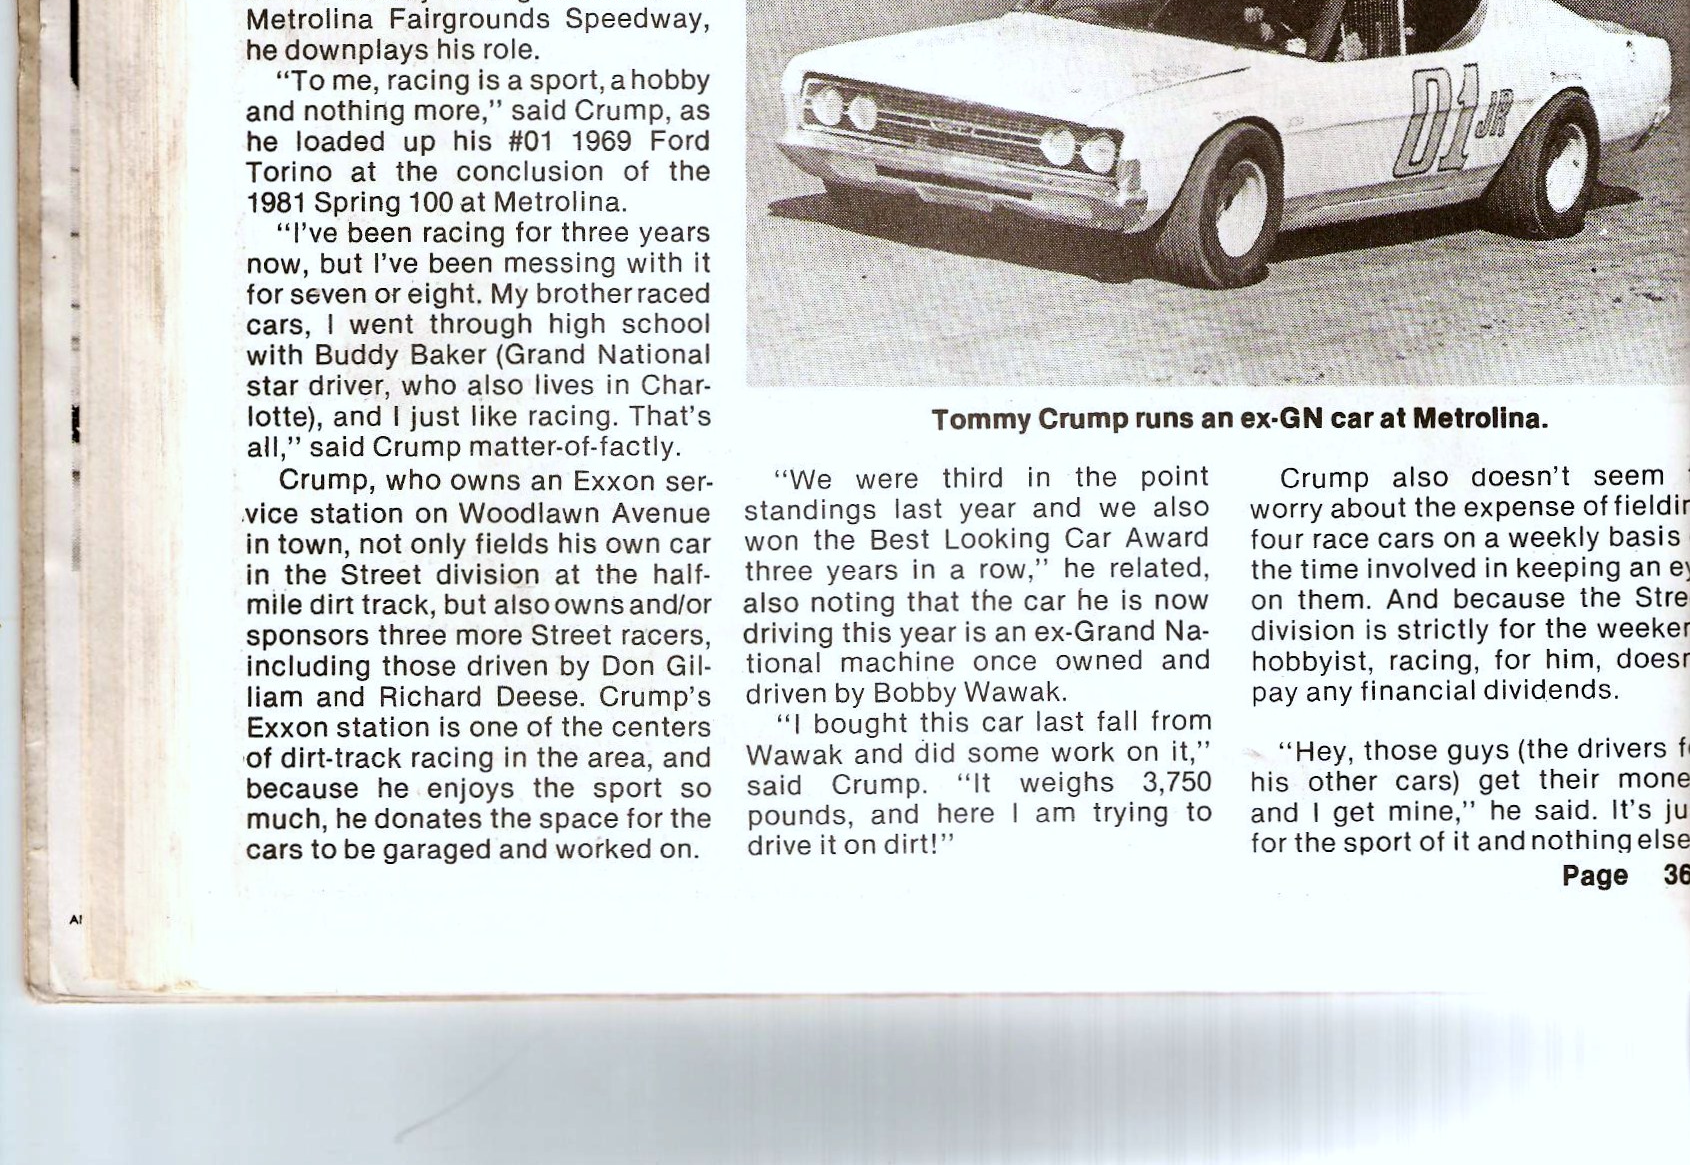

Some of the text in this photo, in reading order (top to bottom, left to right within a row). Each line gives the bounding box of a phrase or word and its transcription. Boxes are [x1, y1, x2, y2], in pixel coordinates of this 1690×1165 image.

[247, 7, 709, 34] Metrolina Fairgrounds Speedway,
[247, 38, 539, 65] he downplays his role.
[1393, 62, 1515, 179] 01 JR
[247, 130, 709, 156] he loaded up his #01 1969 Ford
[248, 191, 626, 217] 1981 Spring 100 at Metrolina.
[247, 343, 709, 370] with Buddy Baker (Grand National
[932, 406, 1548, 434] Tommy Crump runs an ex-GN car at Metrolina.
[280, 468, 713, 494] Crump, who owns an Exxon ser-
[245, 502, 709, 524] vice station on Woodlawn Avenue
[745, 496, 1209, 524] standings last year and we also
[745, 526, 1207, 553] won the Best Looking Car Award
[1251, 525, 1680, 552] four race cars on a weekly basis
[1252, 586, 1688, 610] on them. And because the Stre
[247, 624, 710, 651] sponsors three more Street racers,
[747, 649, 1209, 673] tional machine once owned and
[248, 685, 710, 711] liam and Richard Deese. Crump's
[747, 681, 1066, 708] driven by Bobby Wawak.
[1253, 679, 1618, 707] pay any financial dividends.
[1252, 769, 1690, 795] his other cars) get their mone
[749, 802, 1212, 830] pounds, and here I am trying to
[247, 838, 698, 864] cars to be garaged and worked on.
[1252, 829, 1690, 855] for the sport of it and nothing else
[1564, 863, 1690, 890] Page 36
